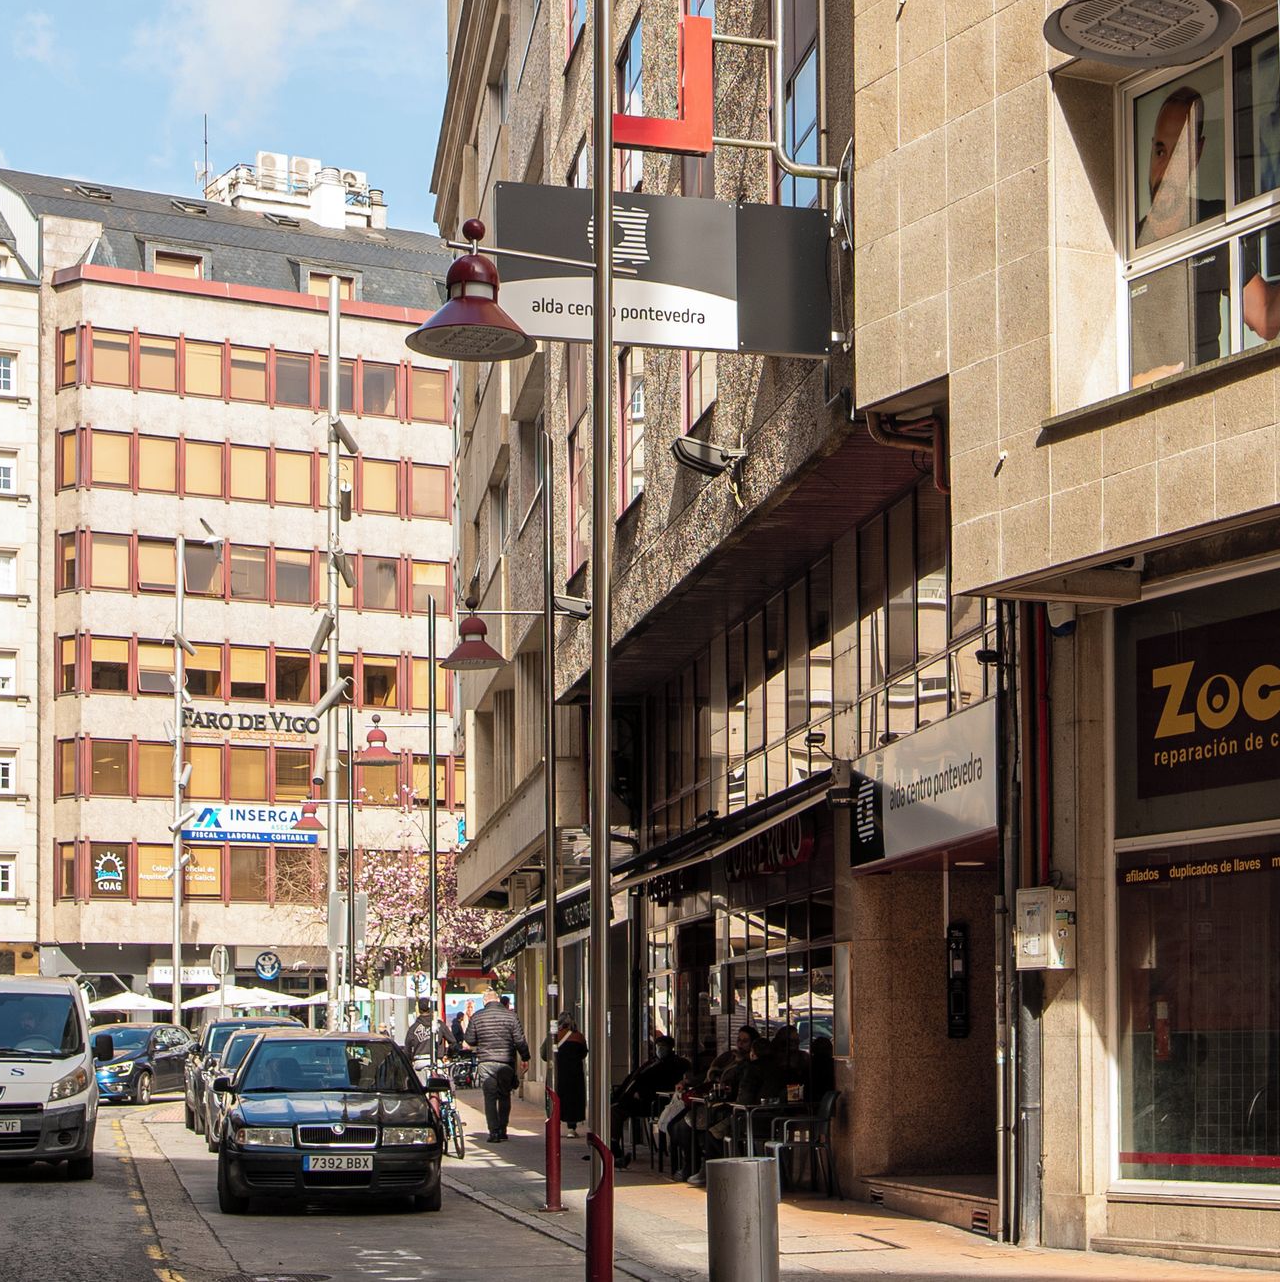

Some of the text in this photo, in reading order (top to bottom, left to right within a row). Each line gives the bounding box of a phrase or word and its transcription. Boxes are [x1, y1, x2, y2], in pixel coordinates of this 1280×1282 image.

[532, 298, 706, 324] alda ceno pontevedra
[182, 707, 320, 734] FARO DE VIGO
[1154, 739, 1238, 768] reparación
[1245, 733, 1263, 751] de
[890, 752, 982, 810] alda centro pontevedra
[230, 809, 303, 823] INSERGA
[191, 831, 218, 839] FISCAL
[227, 832, 260, 840] LABORAL
[1125, 868, 1159, 883] afilados
[1169, 862, 1218, 880] duplicados
[1220, 860, 1232, 872] de
[1234, 858, 1261, 871] llaves
[98, 881, 122, 890] COAG
[311, 1156, 370, 1171] 7392 BBX
